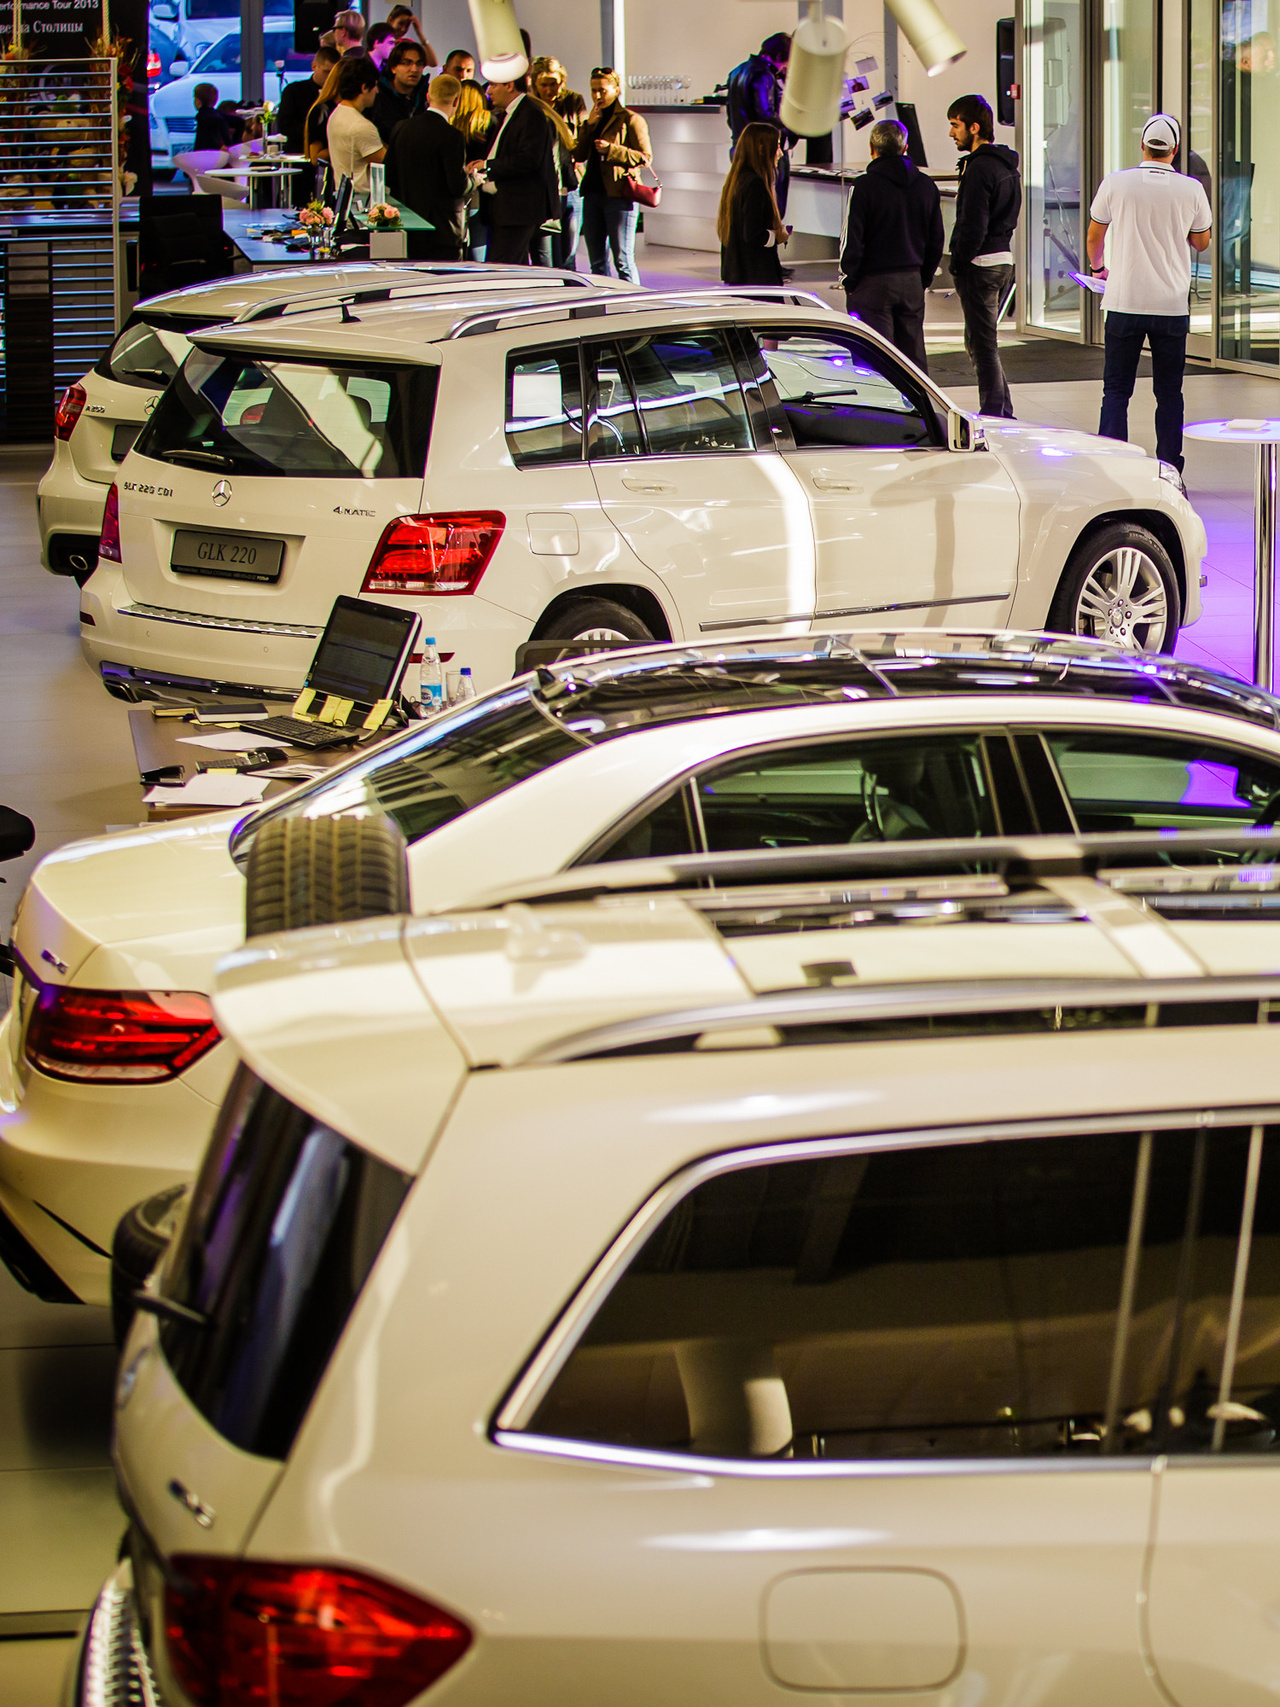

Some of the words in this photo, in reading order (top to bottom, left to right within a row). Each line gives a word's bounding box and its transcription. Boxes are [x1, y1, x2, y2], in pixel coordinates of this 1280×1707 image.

[0, 1, 51, 10] erfomance
[52, 0, 72, 9] Tour
[74, 0, 99, 9] 2013
[33, 20, 83, 33] Столицы
[197, 541, 227, 562] GLK
[229, 545, 258, 565] 220
